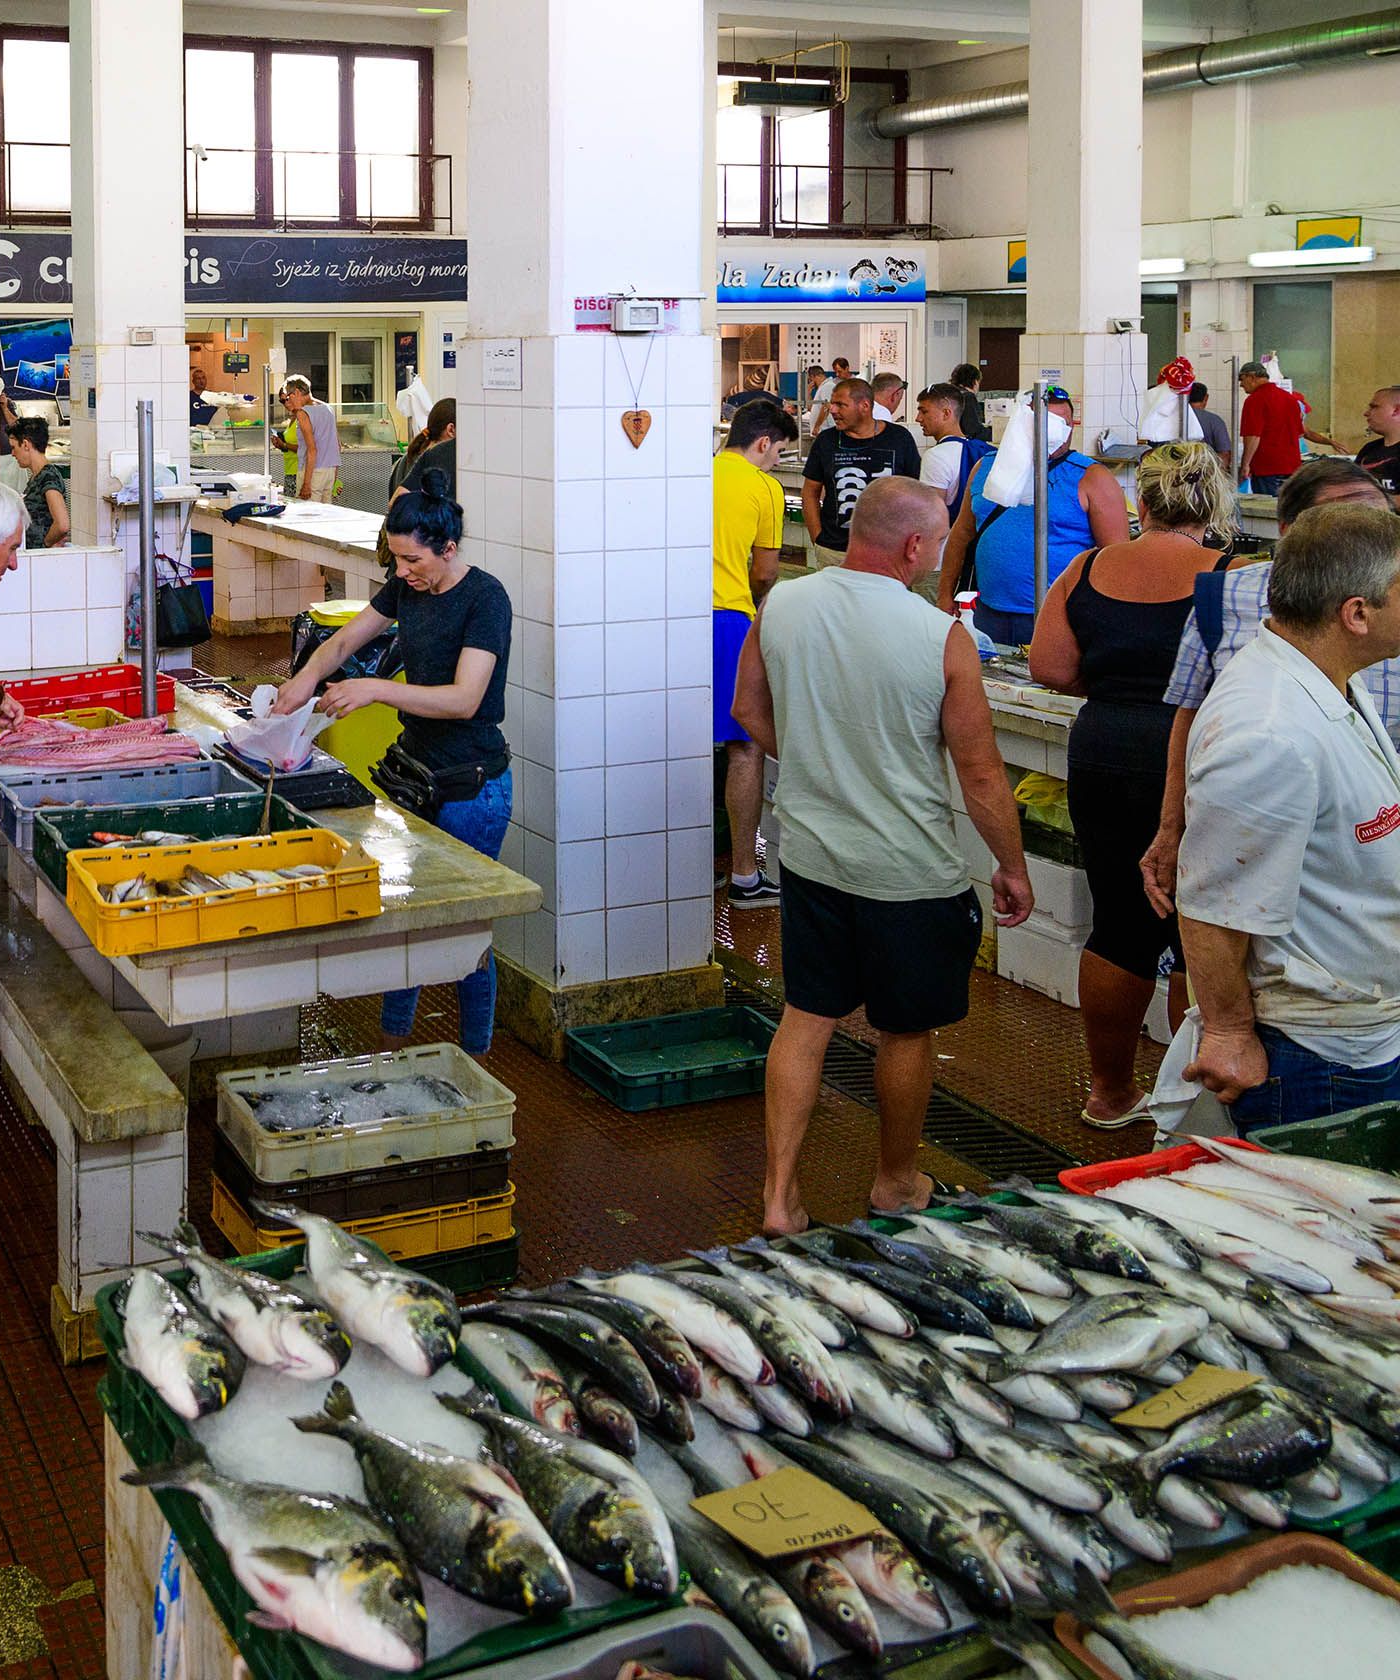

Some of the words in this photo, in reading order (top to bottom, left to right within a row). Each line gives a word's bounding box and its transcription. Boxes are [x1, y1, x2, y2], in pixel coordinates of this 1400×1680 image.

[272, 258, 321, 288] Svježe
[324, 262, 340, 277] iz
[339, 255, 425, 287] Jadranskog
[429, 264, 467, 278] mora
[761, 261, 839, 288] Zadar
[732, 1492, 810, 1523] 70
